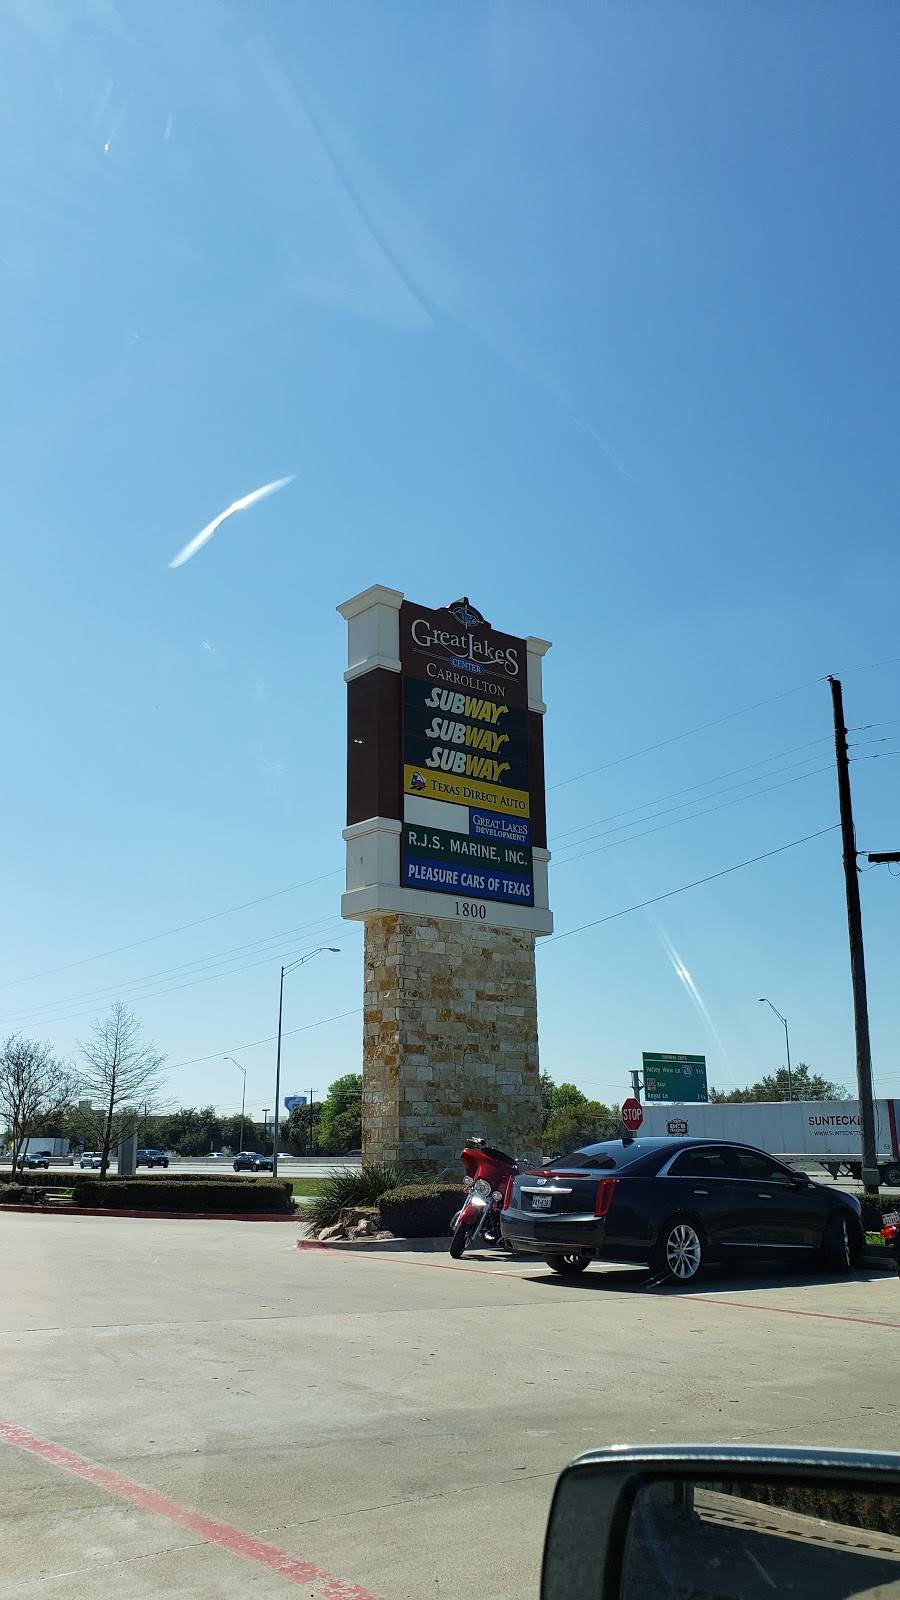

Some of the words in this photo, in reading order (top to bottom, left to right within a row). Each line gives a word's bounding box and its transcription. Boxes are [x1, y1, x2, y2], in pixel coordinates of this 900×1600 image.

[426, 662, 505, 697] CARROLLTON
[451, 659, 481, 674] CENTER
[424, 687, 509, 724] SUBWAY
[424, 717, 510, 753] SUBWAY
[425, 746, 511, 782] SUBWAY
[431, 779, 460, 796] TEXAS
[463, 786, 498, 804] DIRECT
[500, 795, 526, 809] AUTO
[472, 814, 501, 829] GREAT
[502, 820, 528, 835] LAKES
[475, 826, 526, 842] DEVELOPMENT
[408, 831, 445, 850] R.J.S.
[450, 839, 501, 862] MARINE,
[505, 849, 528, 866] INC.
[408, 863, 458, 885] PLEASURE
[460, 873, 485, 890] CARS
[487, 877, 500, 892] OF
[502, 879, 531, 897] TEXAS
[455, 901, 487, 919] 1800
[623, 1108, 641, 1121] STOP
